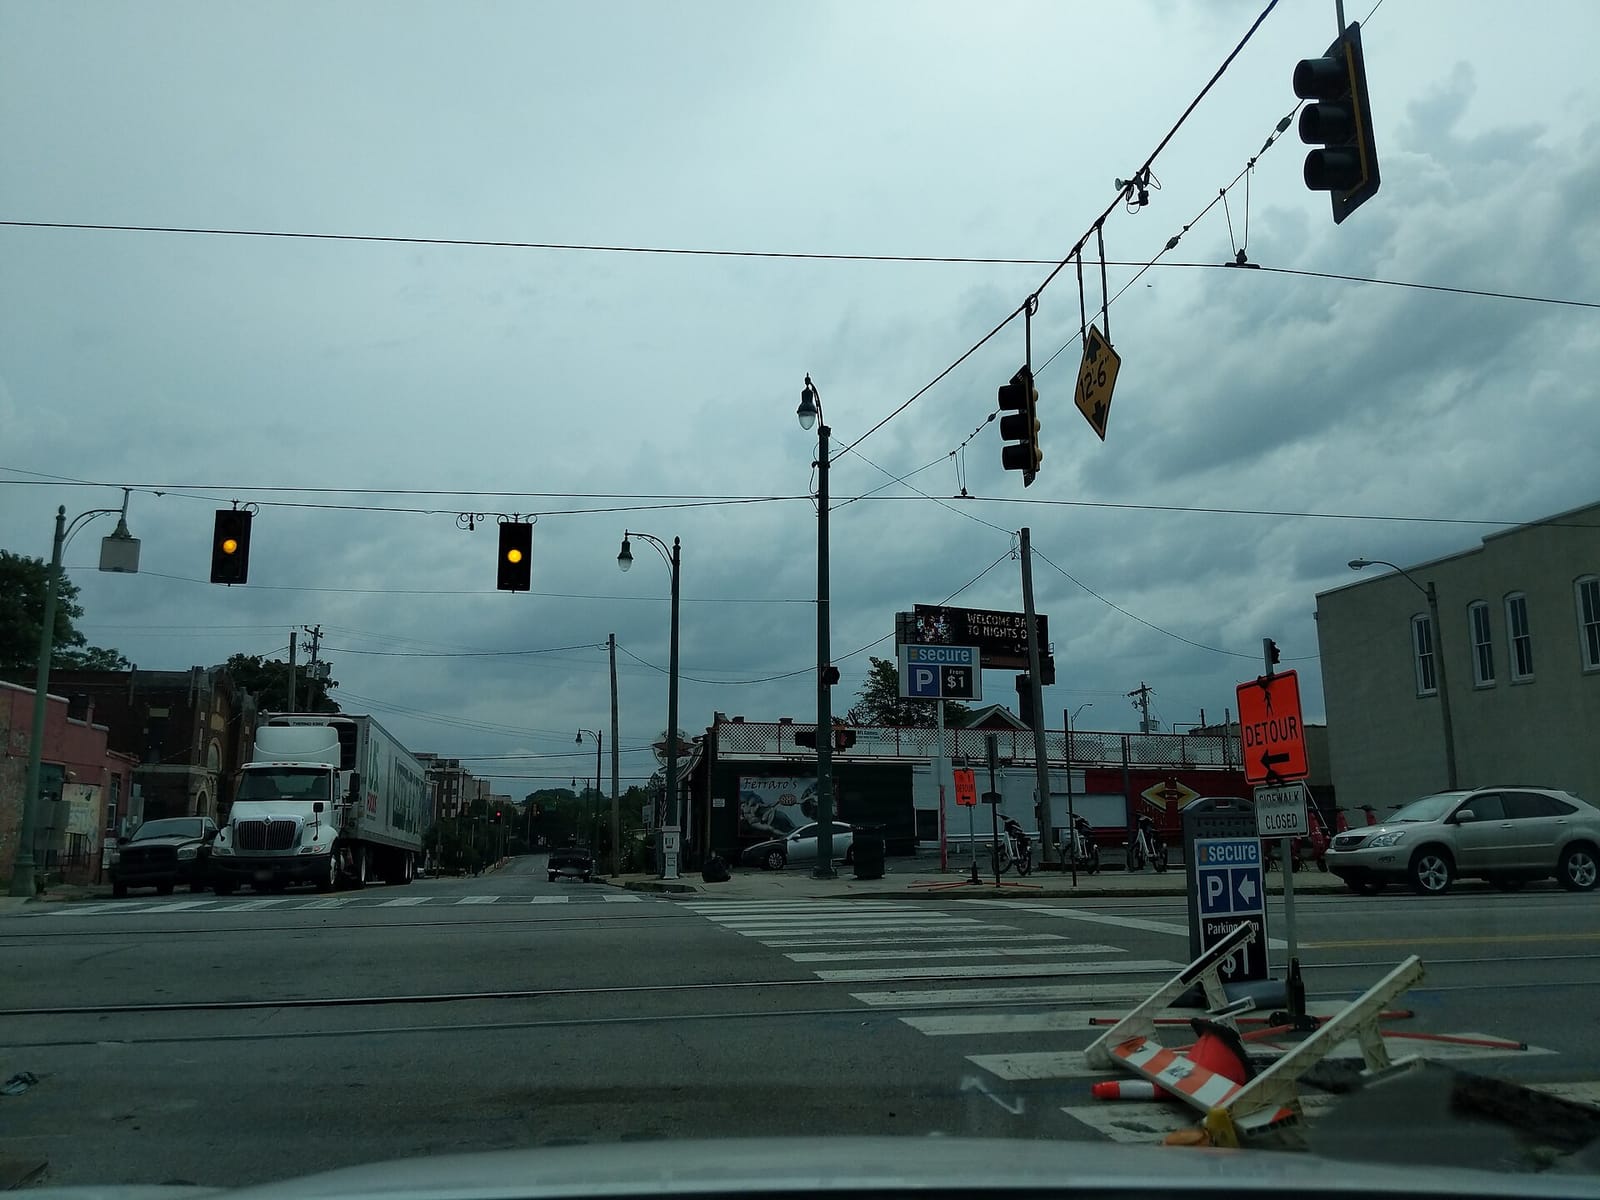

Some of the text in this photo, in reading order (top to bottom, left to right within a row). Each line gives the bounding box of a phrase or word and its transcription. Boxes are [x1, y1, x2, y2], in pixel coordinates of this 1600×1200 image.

[966, 613, 1010, 627] WELCOME
[967, 625, 980, 636] TO
[983, 626, 1018, 639] NIGHTS
[918, 648, 970, 662] secure
[916, 669, 934, 692] P
[947, 676, 965, 689] $1
[1245, 716, 1299, 747] DETOUR
[743, 776, 797, 790] Ferraro's
[1266, 813, 1298, 830] CLOSED
[1208, 844, 1257, 862] secure
[1206, 875, 1224, 907] P
